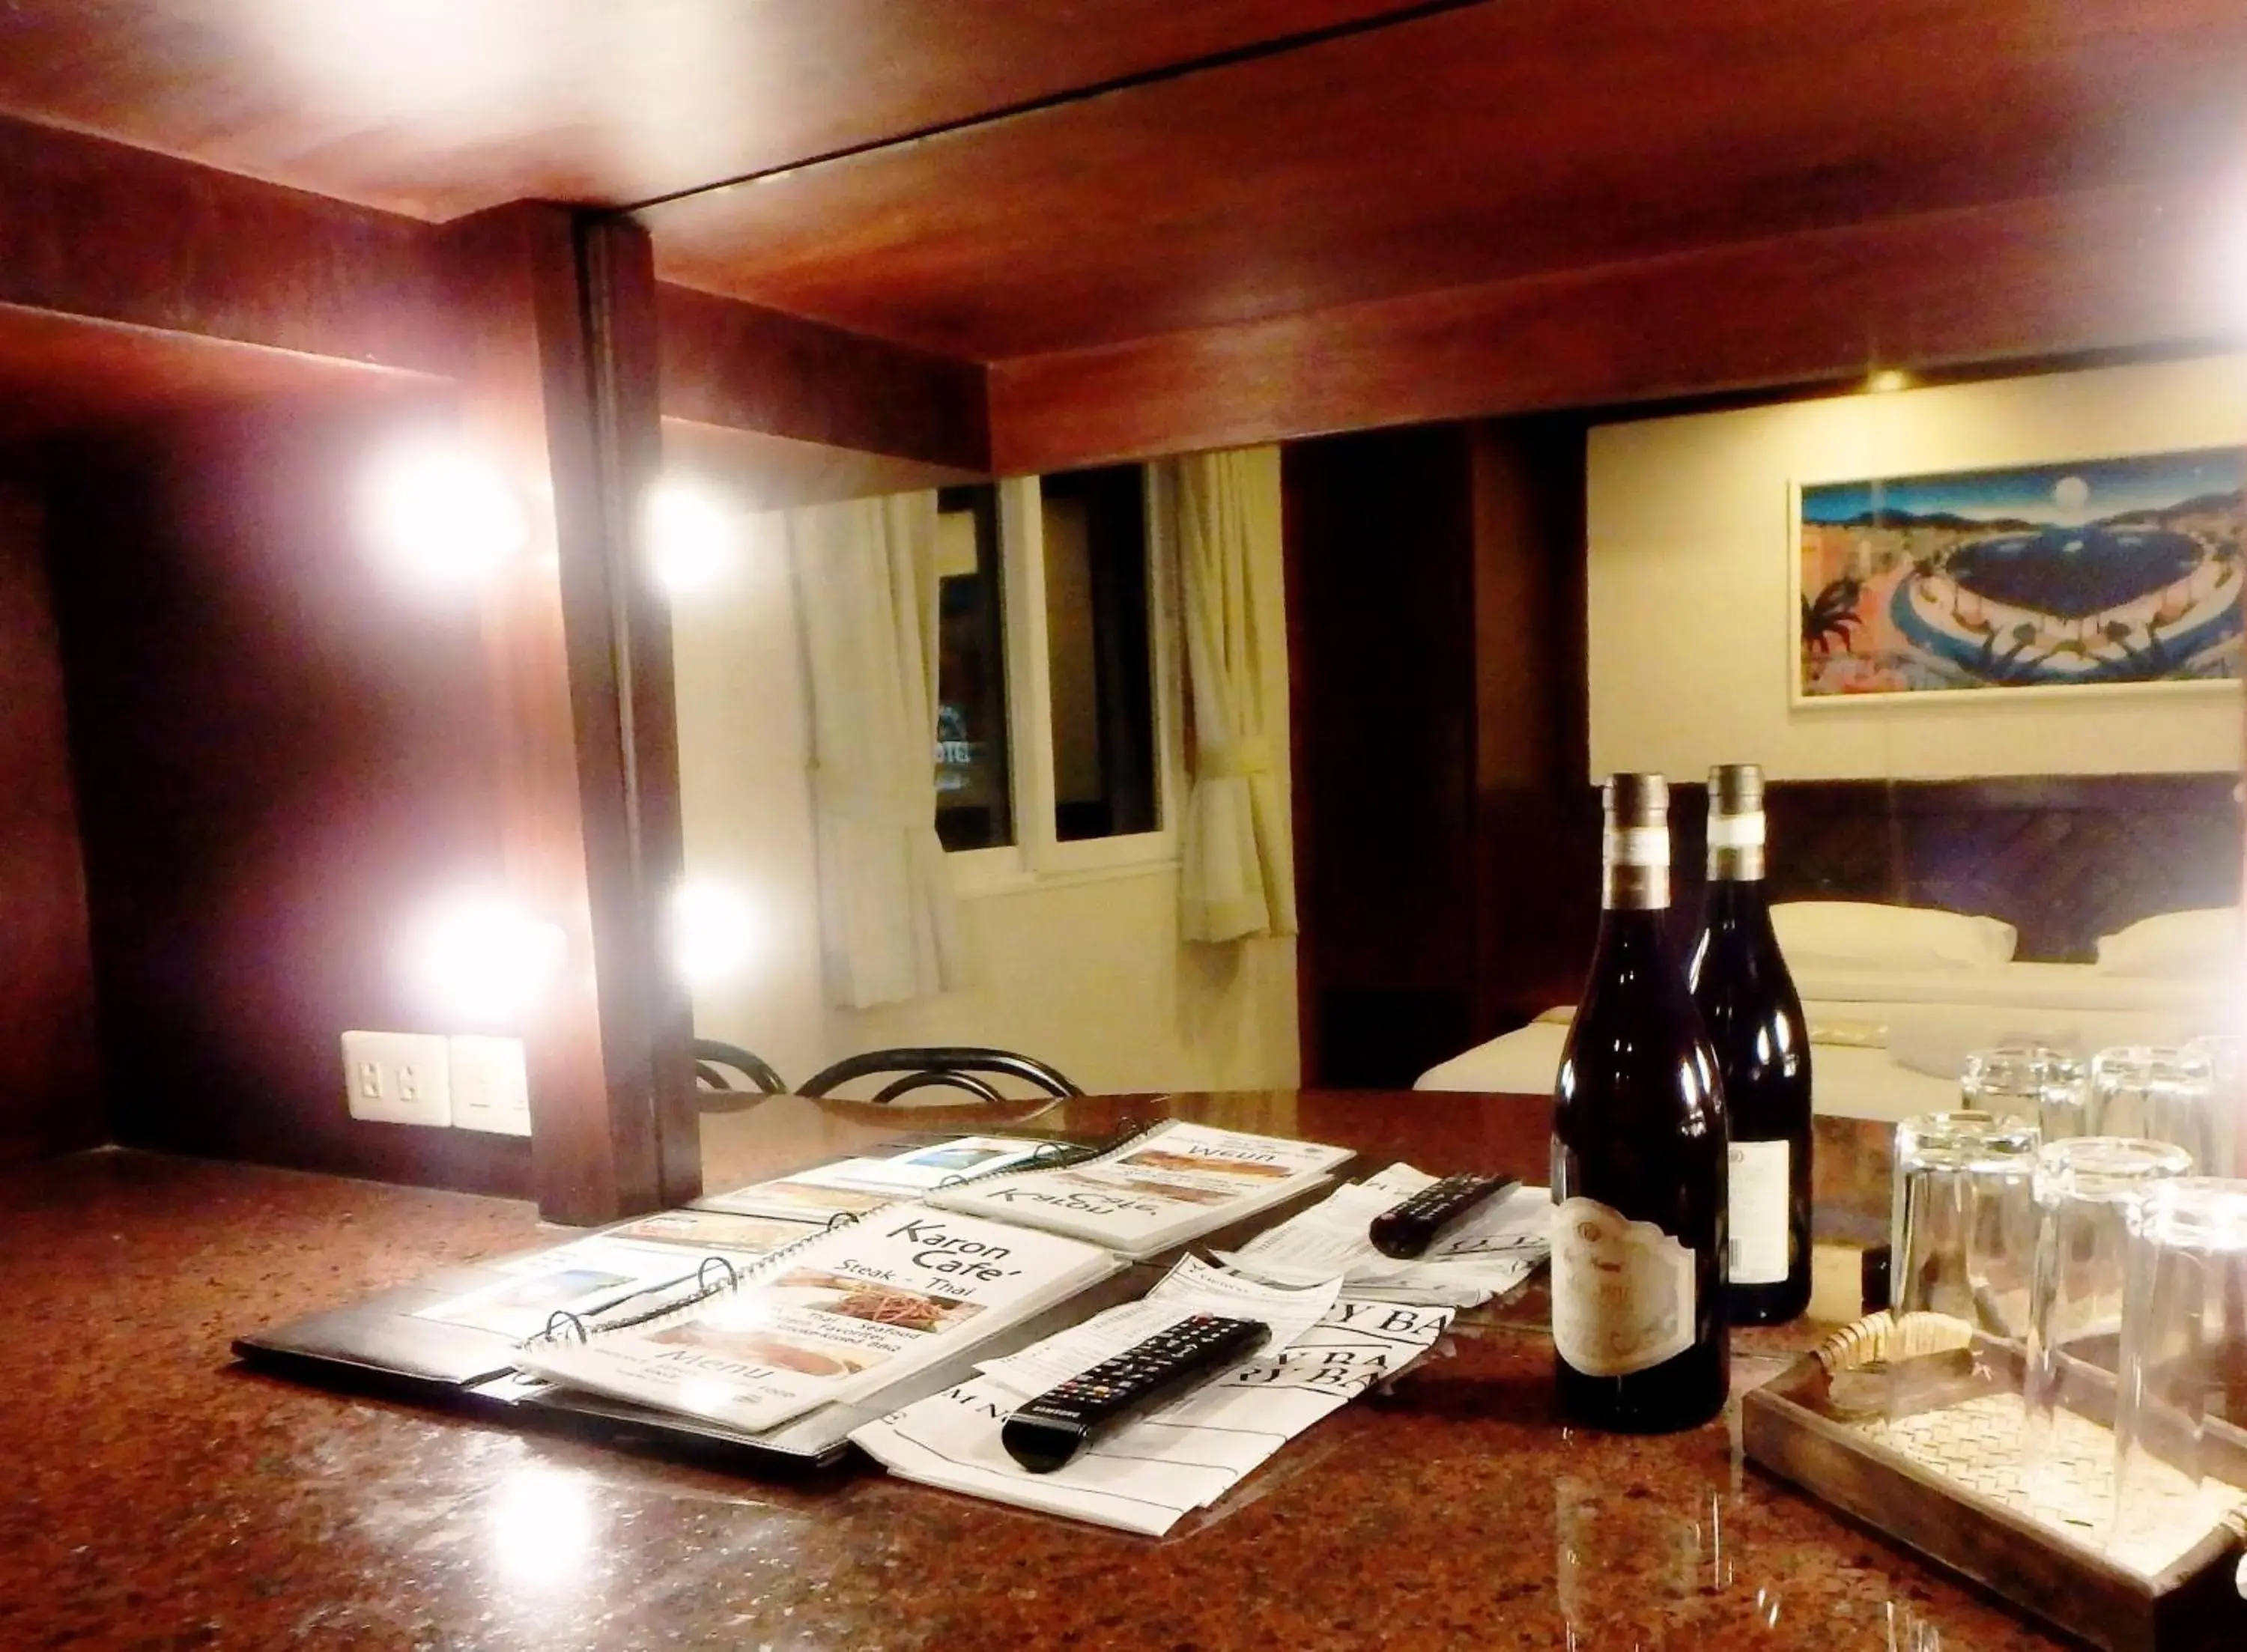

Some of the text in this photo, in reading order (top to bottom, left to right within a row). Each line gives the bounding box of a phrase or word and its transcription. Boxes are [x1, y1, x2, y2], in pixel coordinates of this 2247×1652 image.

[887, 1219, 1010, 1260] Karon
[834, 1259, 897, 1280] Steak
[925, 1277, 976, 1296] Thai
[655, 1350, 774, 1379] Menu
